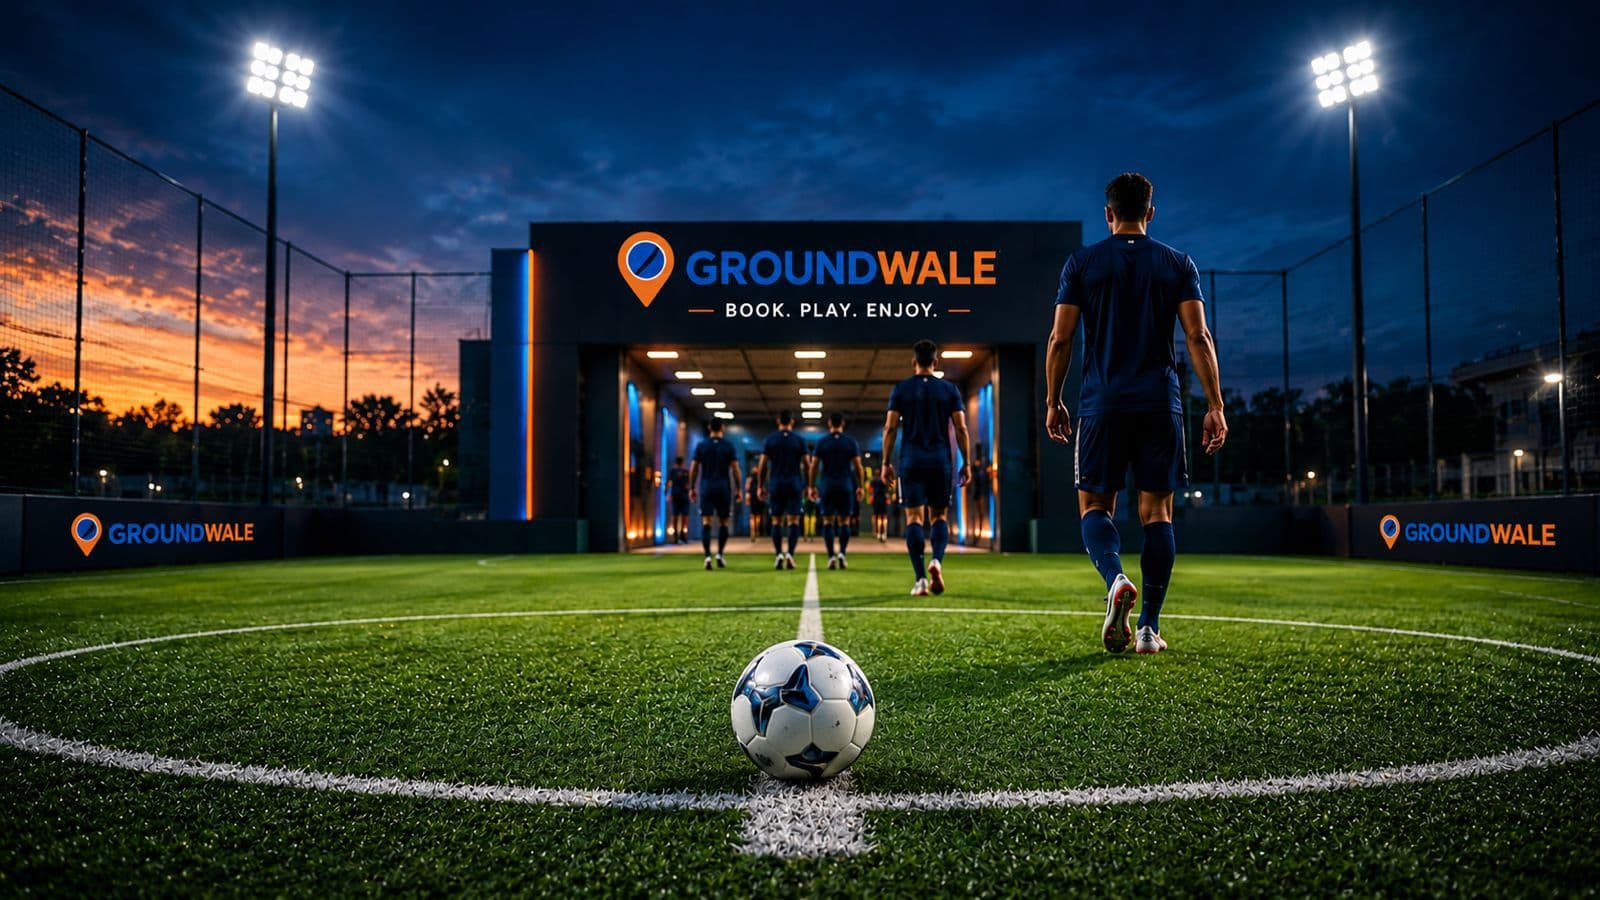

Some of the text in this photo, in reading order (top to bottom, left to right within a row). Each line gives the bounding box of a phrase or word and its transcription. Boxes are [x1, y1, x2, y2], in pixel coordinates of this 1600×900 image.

[686, 250, 997, 286] GROUNDWALE
[725, 302, 938, 318] BOOK. PLAY. ENJOY.
[108, 522, 254, 545] GROUNDWALE
[1404, 522, 1556, 547] GROUNDWALE
